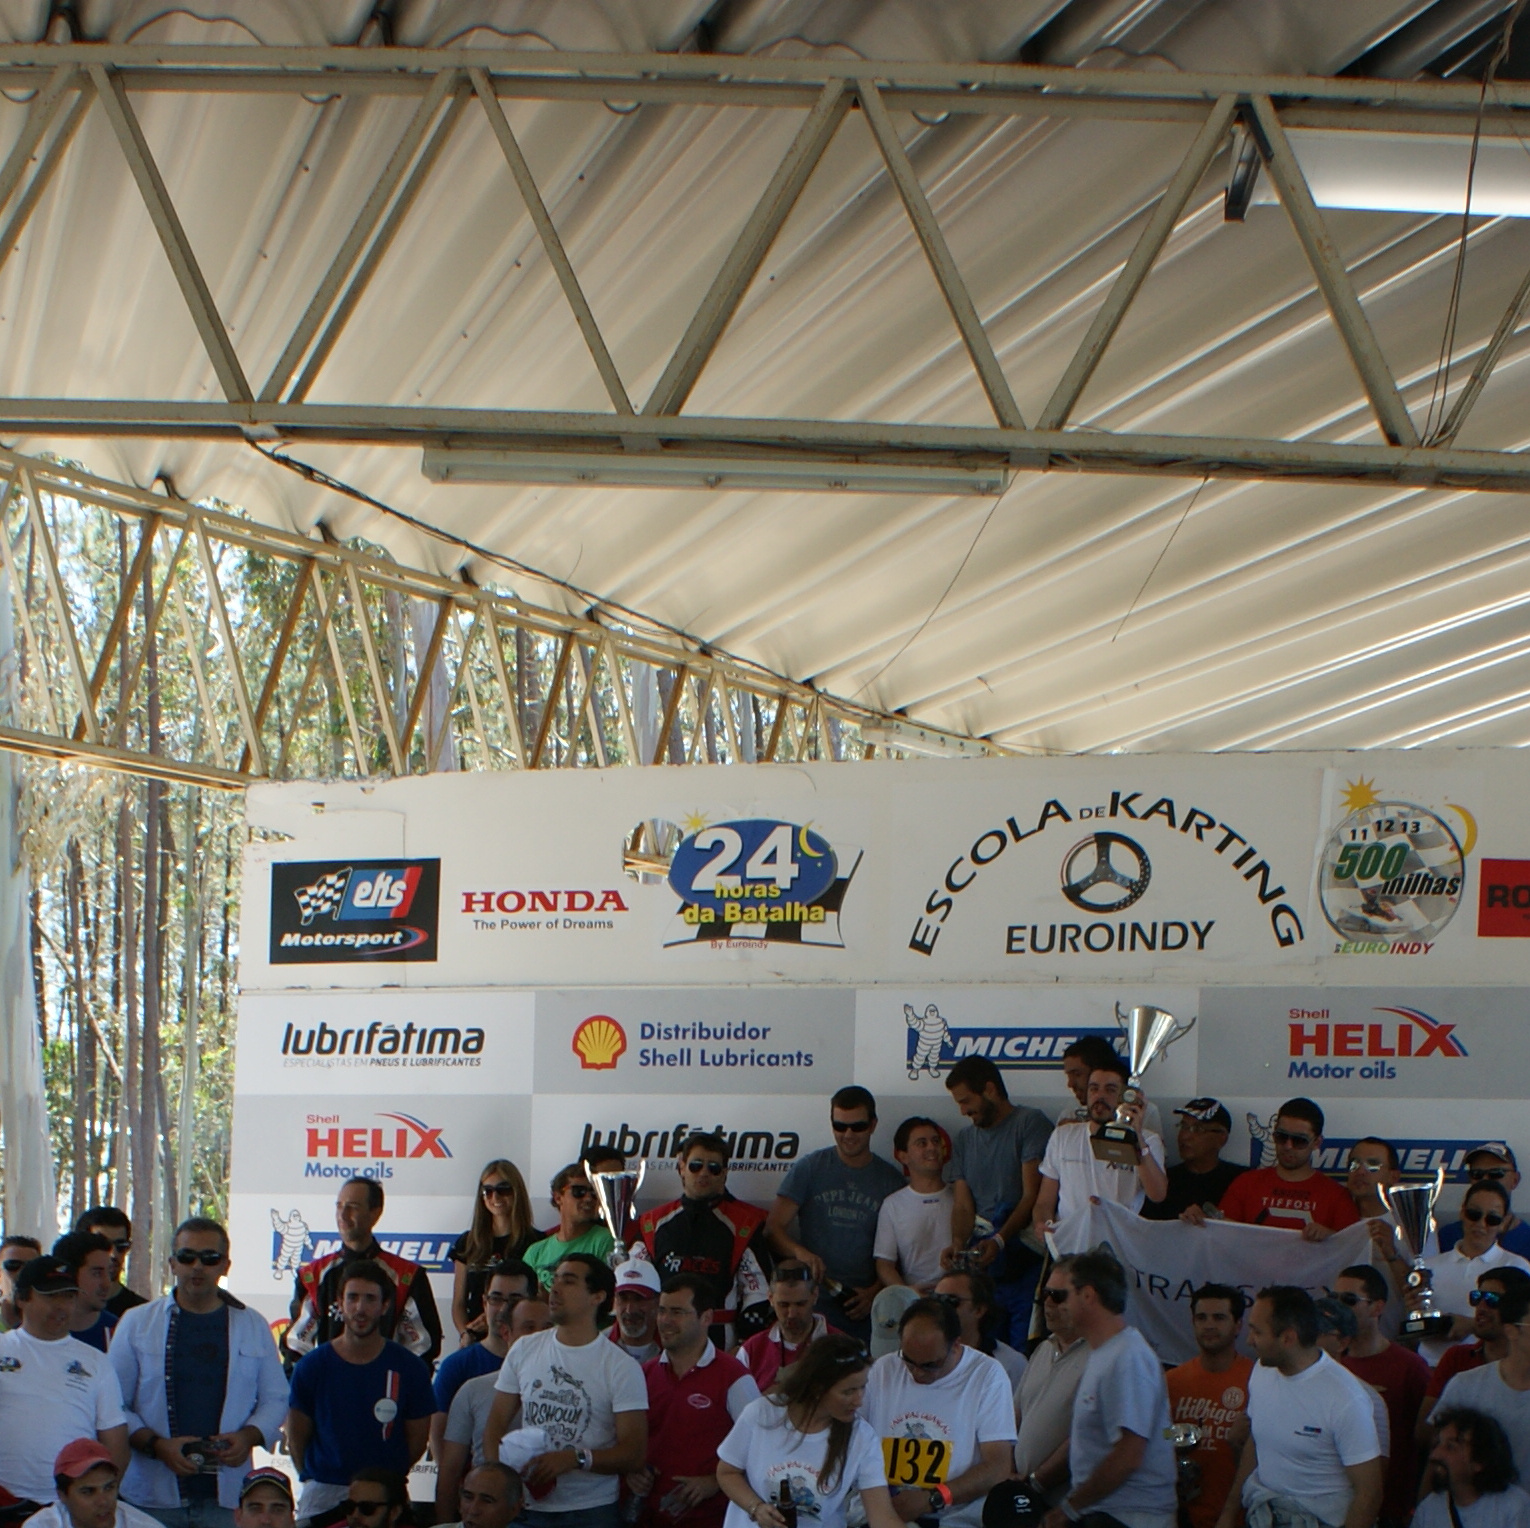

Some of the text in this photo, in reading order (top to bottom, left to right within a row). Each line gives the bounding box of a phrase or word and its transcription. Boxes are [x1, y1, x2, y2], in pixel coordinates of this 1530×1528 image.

[1349, 820, 1421, 842] 11 12 13
[691, 825, 799, 891] 24
[1334, 841, 1411, 881] 500
[908, 791, 1305, 957] ESCOLA DE KARTING
[715, 881, 783, 899] horas
[461, 889, 629, 914] HONDA
[683, 902, 826, 924] da Batalha
[473, 918, 615, 931] The Power of Dreams
[280, 930, 404, 949] Motorsport
[1005, 920, 1216, 956] EUROINDY
[1341, 942, 1435, 956] EUROINDY
[1288, 1008, 1330, 1020] Shell
[639, 1021, 772, 1041] Distribuidor
[1288, 1018, 1462, 1058] HELIX
[369, 1057, 400, 1068] PNEUS
[402, 1057, 408, 1067] E
[410, 1057, 482, 1068] LUBRIFICANTES
[638, 1048, 814, 1068] Shell Lubricants
[1287, 1061, 1397, 1080] Motor oils
[306, 1114, 340, 1124] Shell
[306, 1121, 450, 1158] HELIX
[304, 1161, 394, 1179] Motor oils
[1262, 1196, 1318, 1212] TIFFOSI
[887, 1437, 946, 1485] 132
